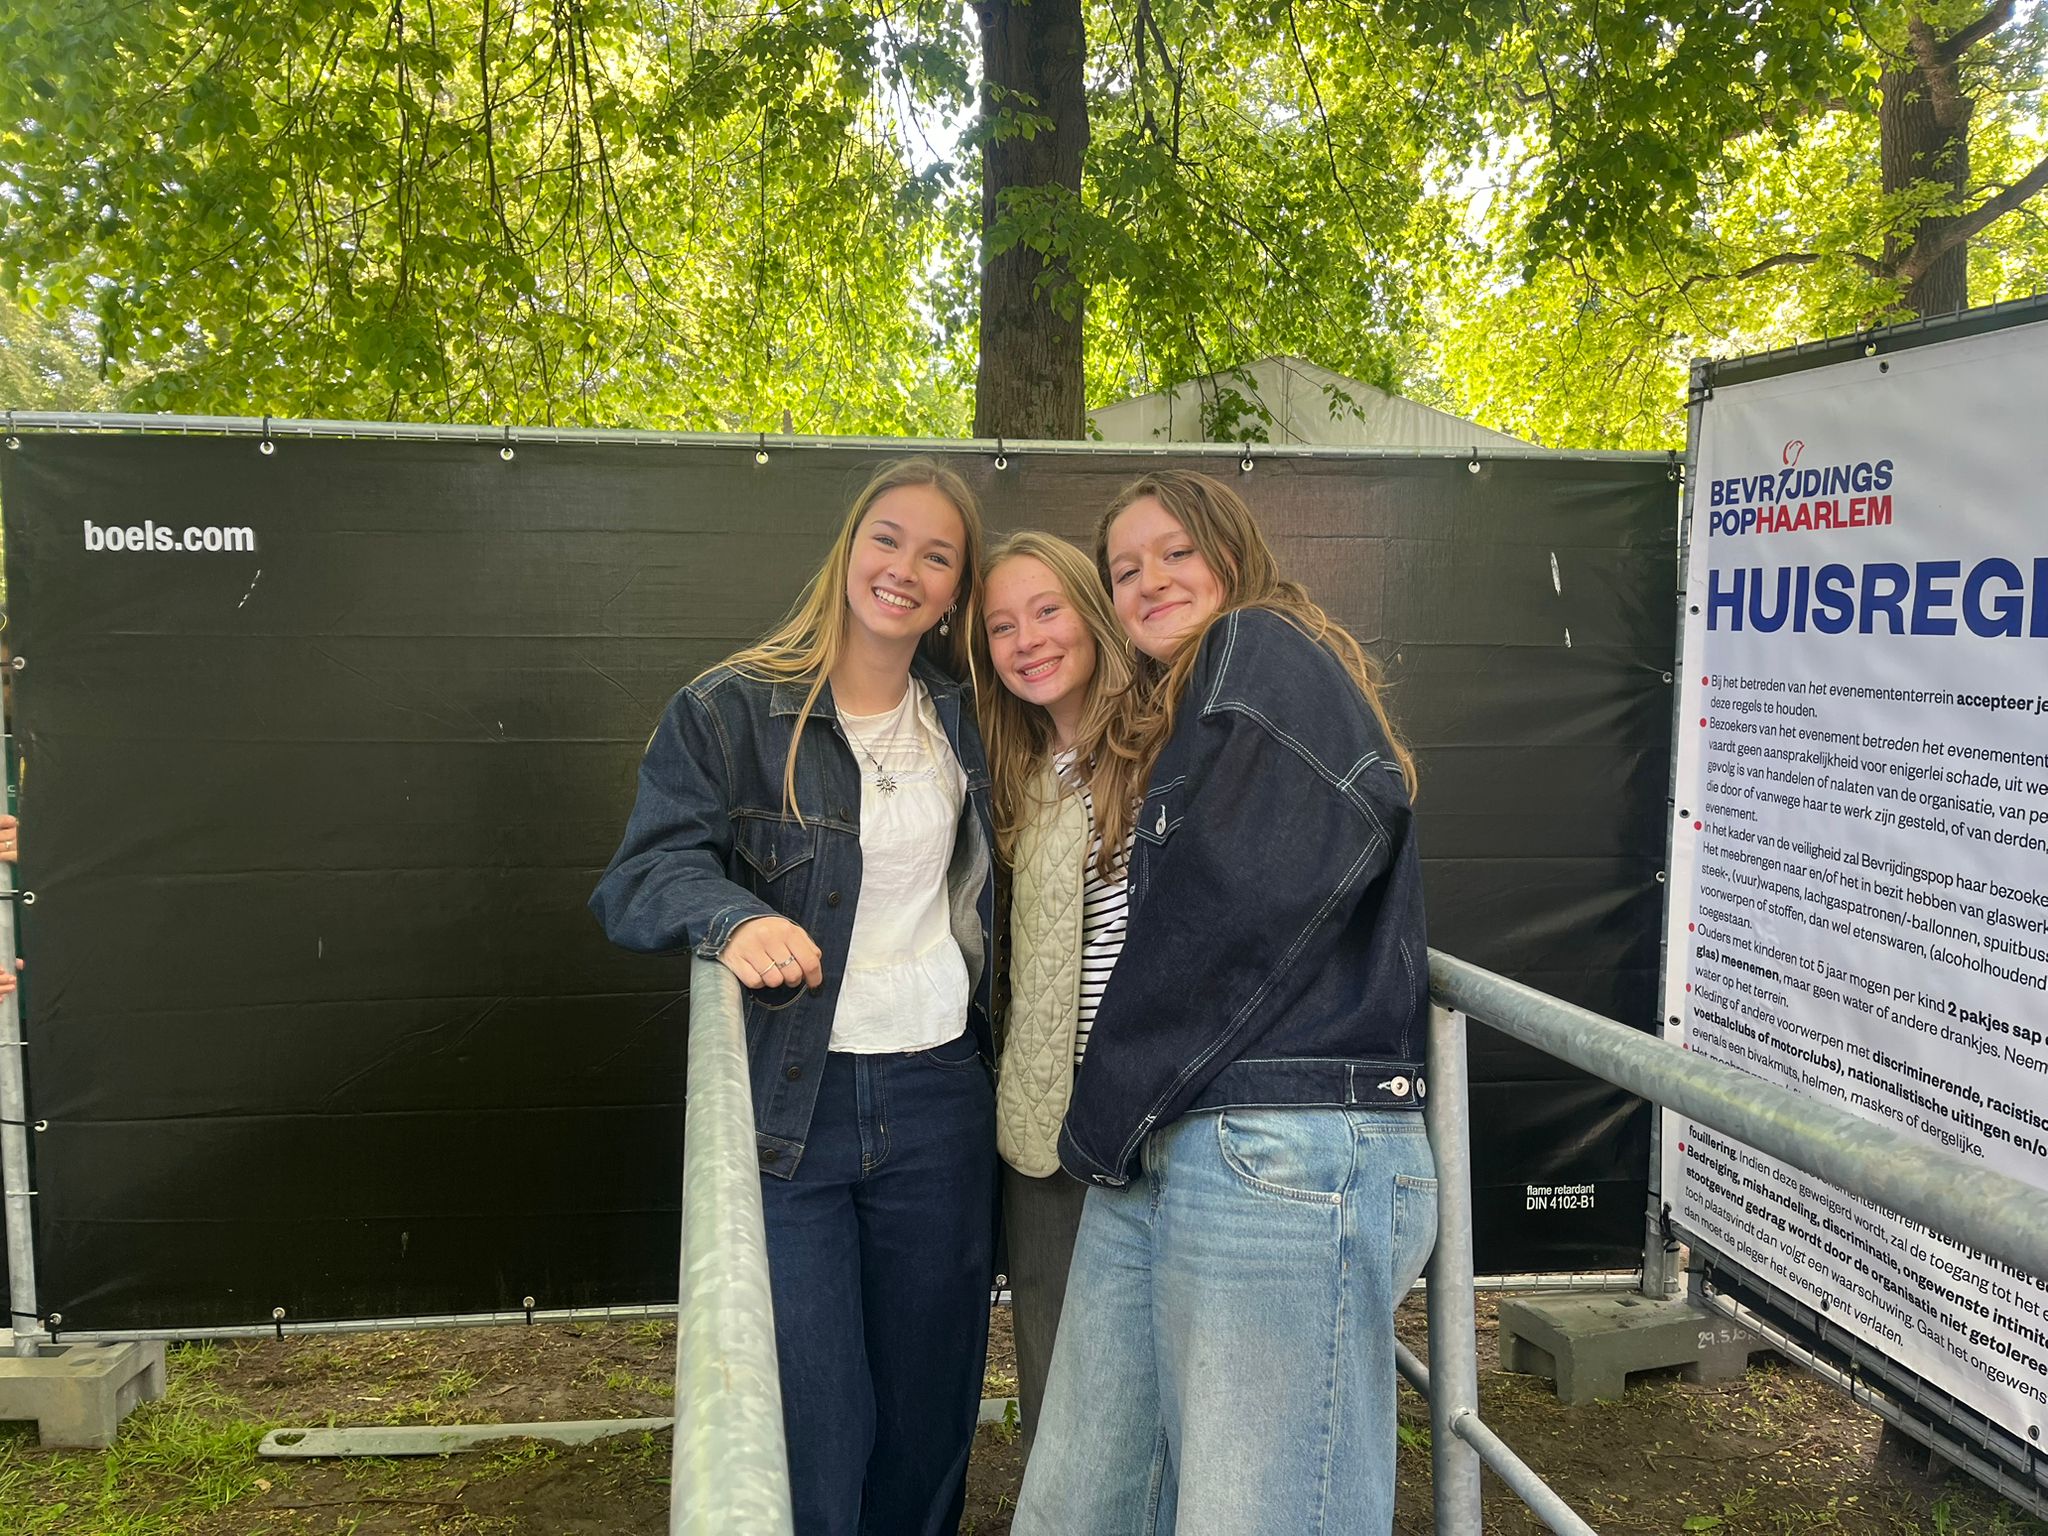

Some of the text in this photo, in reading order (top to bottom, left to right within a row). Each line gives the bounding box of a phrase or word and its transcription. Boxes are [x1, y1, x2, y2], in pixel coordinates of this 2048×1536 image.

[84, 520, 255, 552] boels.com
[1711, 696, 1817, 717] deze regels houden.
[1723, 676, 2048, 715] het betreden van het evenemententerrein accepteer je
[1709, 740, 2048, 795] vaardt geen aansprakelijkheid voor enigerlei schade, uit we
[1710, 717, 1944, 755] Bezoekers het evenement betreden het
[1706, 802, 1758, 822] evenement.
[1708, 761, 2048, 825] gevolg handelen nalaten van de organisatie, van pe
[1721, 783, 1990, 841] door vanwege haar werk zijn gesteld, of van
[1703, 841, 1983, 919] Het meebrengen naar en/of het bezit hebben van
[1712, 823, 1726, 837] het
[1728, 827, 1755, 842] kader
[1757, 835, 1774, 847] van
[1792, 841, 1841, 861] veiligheid
[1843, 852, 1859, 865] zal
[1862, 853, 1953, 888] Bevrijdingspop
[1957, 873, 1987, 892] haar
[1700, 905, 1752, 928] toegestaan.
[1700, 885, 2047, 990] voorwerpen stoffen, dan wel etenswaren, (alcoholhoudend
[1702, 864, 1980, 946] steek-, (vuur)wapens, lachgaspatronen/-ballonnen,
[1696, 967, 1789, 1007] water het terrein.
[1696, 946, 1719, 964] glas)
[1722, 953, 1781, 983] meenemen,
[1783, 975, 1811, 992] maar
[1813, 986, 1840, 1002] geen
[1843, 995, 1874, 1014] water
[1876, 1006, 1890, 1019] of
[1891, 1011, 1937, 1035] andere
[1941, 1026, 2000, 1058] drankjes.
[1698, 924, 1730, 944] Ouders
[1733, 936, 1752, 951] met
[1754, 941, 1797, 965] kinderen
[1799, 957, 1815, 971] tot
[1825, 963, 1847, 981] jaar
[1850, 973, 1890, 995] mogen
[1894, 986, 1915, 1002] per
[1918, 992, 1945, 1013] kind
[1960, 1009, 2009, 1033] pakjes
[2012, 1025, 2042, 1045] sap
[1693, 1028, 1727, 1048] evenals
[1729, 1042, 1745, 1056] een
[1747, 1050, 1800, 1082] bivakmuts,
[1802, 1071, 1847, 1101] helmen,
[1850, 1092, 1903, 1122] maskers
[1921, 1121, 1984, 1158] dergelijke.
[1694, 1007, 1756, 1039] voetbalclubs
[1771, 1038, 1844, 1076] motorclubs),
[1848, 1066, 1948, 1117] nationalistische
[1952, 1109, 2010, 1142] uitingen
[2014, 1135, 2047, 1156] en/o
[1695, 984, 2048, 1131] Kleding andere voorwerpen met discriminerende, racistisc
[1526, 1195, 1595, 1210] DIN 4102-B1
[1527, 1183, 1595, 1195] flame retardant
[1687, 1145, 1989, 1318] Bedreiging, mishandeling, discriminatie, ongewenste
[1739, 1151, 2039, 1316] Indien deze geweigerd wordt, zal de toegang tot het
[1684, 1207, 1903, 1346] dan moet pleger het evenement verlaten.
[1685, 1186, 2047, 1404] toch plaatsvindt dan volgt een waarschuwing. Gaat het ongewens
[1686, 1167, 2047, 1376] stootgevend gedrag wordt door de organisatie niet getoleree
